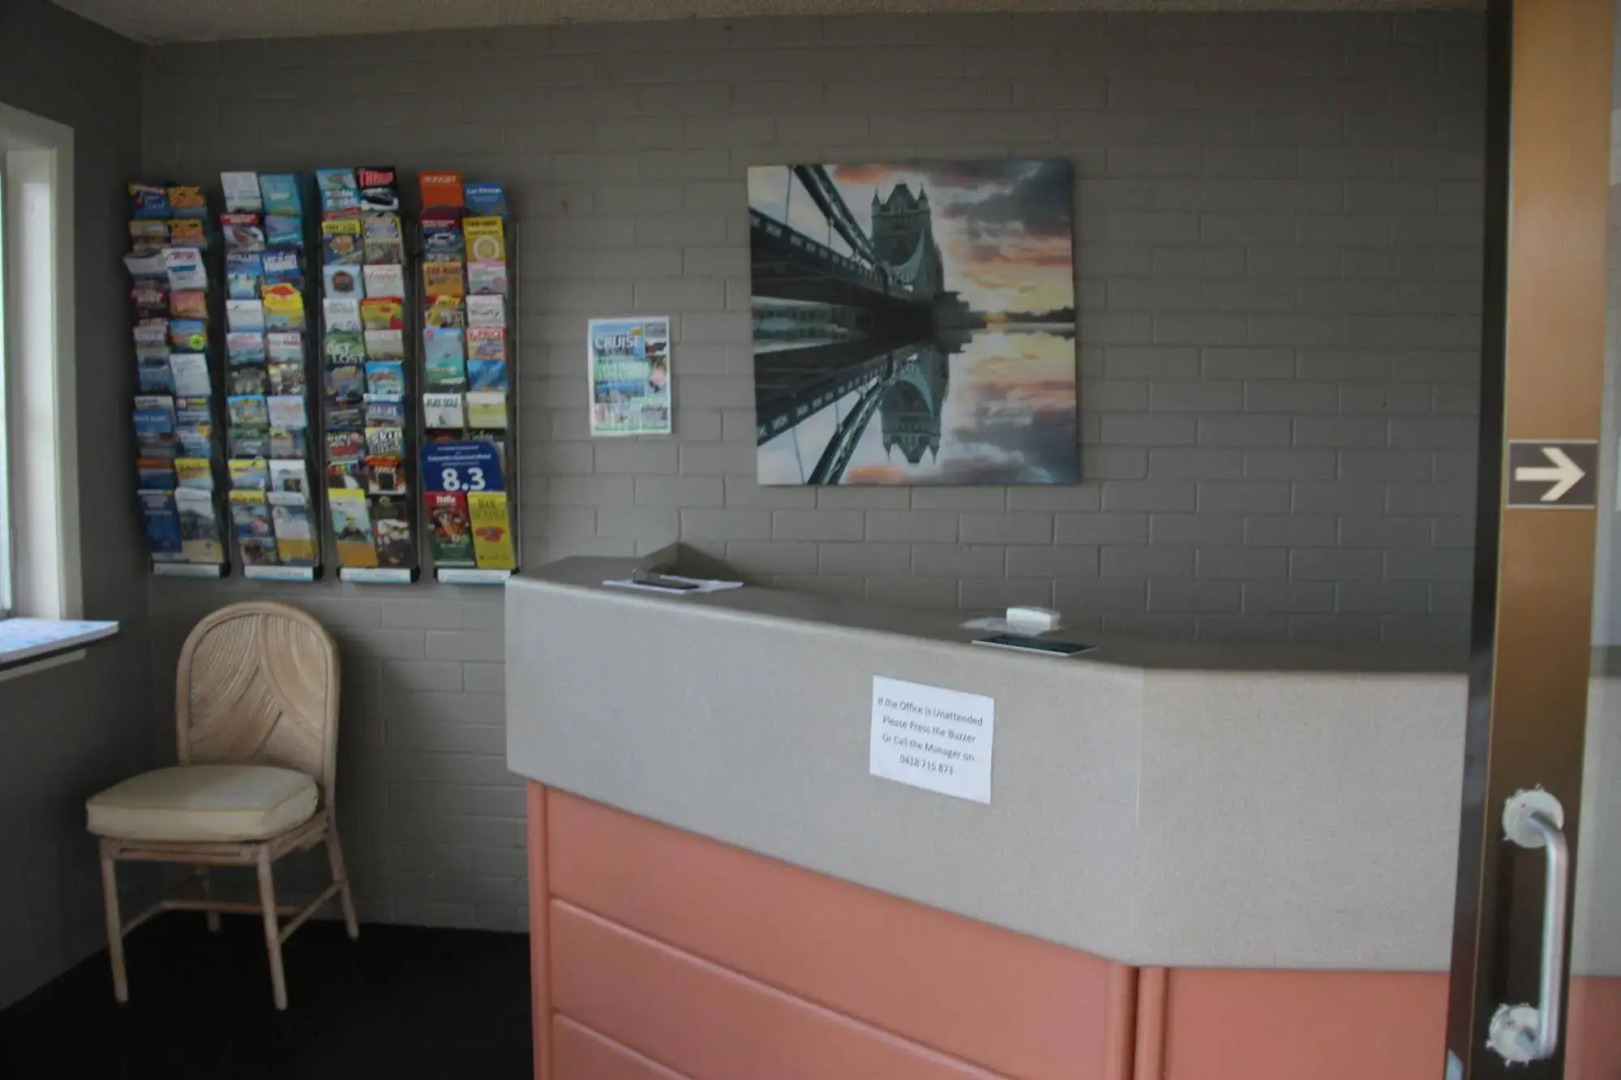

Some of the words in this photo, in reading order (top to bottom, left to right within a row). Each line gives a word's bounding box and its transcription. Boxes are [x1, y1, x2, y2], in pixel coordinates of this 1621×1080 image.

[595, 334, 640, 349] CRUISE
[442, 467, 486, 491] 8.3
[878, 697, 884, 705] If
[885, 698, 898, 708] the
[900, 701, 923, 713] Office
[925, 707, 932, 716] is
[933, 707, 983, 727] Unattended
[883, 715, 907, 729] Please
[909, 721, 930, 734] Press
[932, 726, 946, 737] the
[948, 729, 976, 743] Buzzer
[882, 733, 892, 743] Or
[893, 735, 908, 747] Call
[909, 739, 923, 750] the
[924, 742, 961, 759] Manager
[963, 753, 975, 762] on
[899, 754, 920, 768] 0418
[922, 761, 936, 772] 715
